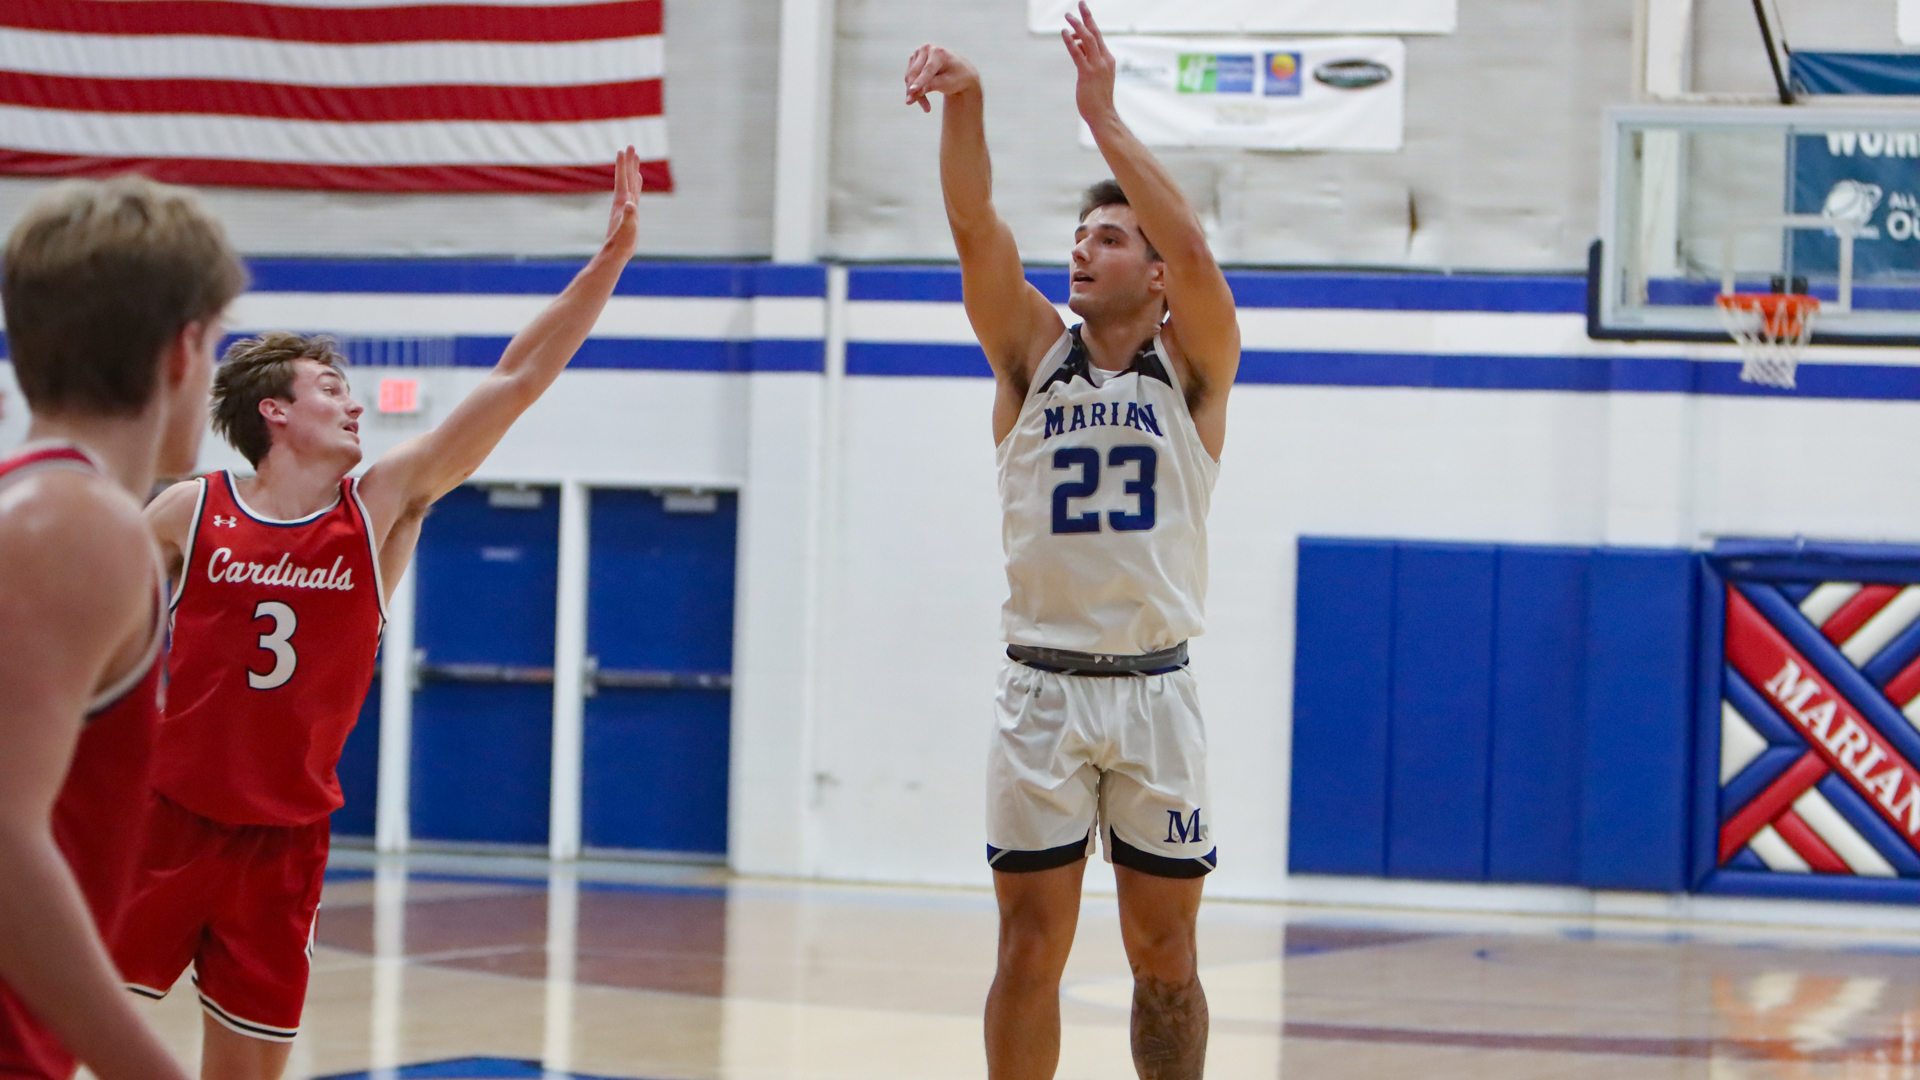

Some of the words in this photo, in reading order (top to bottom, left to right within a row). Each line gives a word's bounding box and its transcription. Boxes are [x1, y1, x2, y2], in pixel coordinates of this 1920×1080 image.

[1043, 401, 1164, 440] MARIAN
[1050, 444, 1158, 535] 23
[207, 546, 355, 591] Cardinals
[246, 599, 298, 690] 3
[1163, 807, 1203, 844] M
